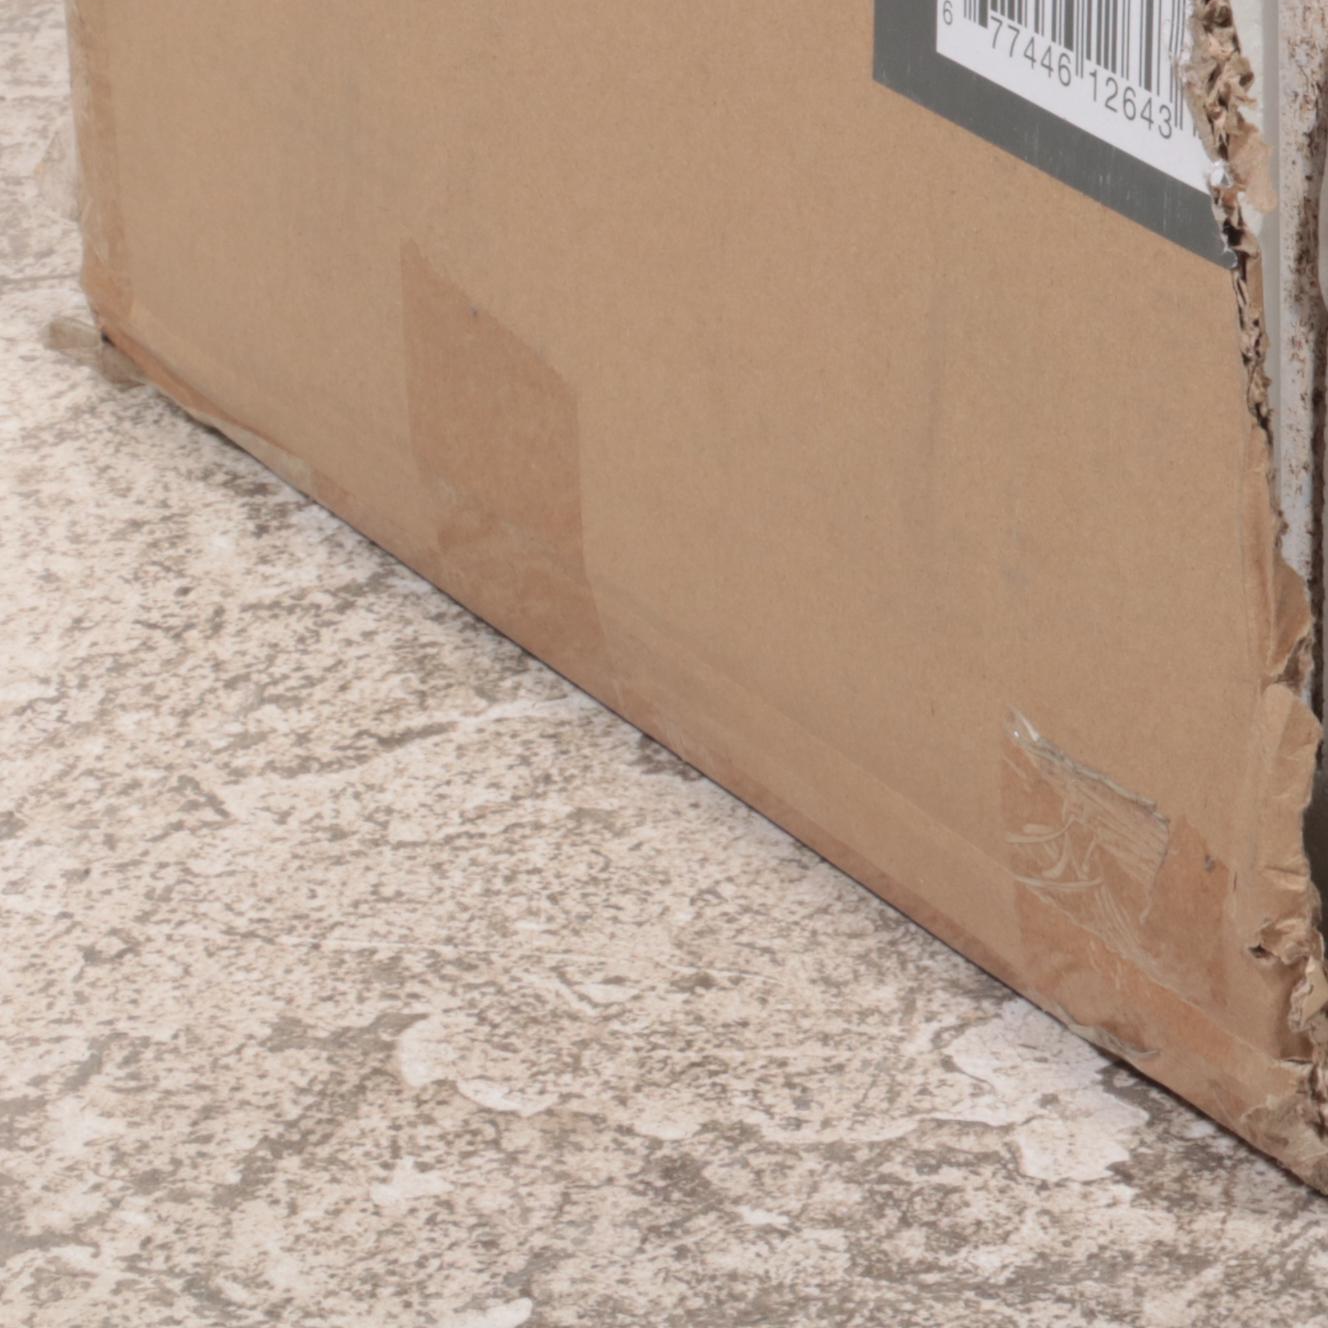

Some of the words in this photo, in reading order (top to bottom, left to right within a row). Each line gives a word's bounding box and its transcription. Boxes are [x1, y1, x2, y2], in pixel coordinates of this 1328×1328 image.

[943, 0, 953, 26] 6
[991, 16, 1072, 87] 77446
[1090, 69, 1173, 140] 12643
